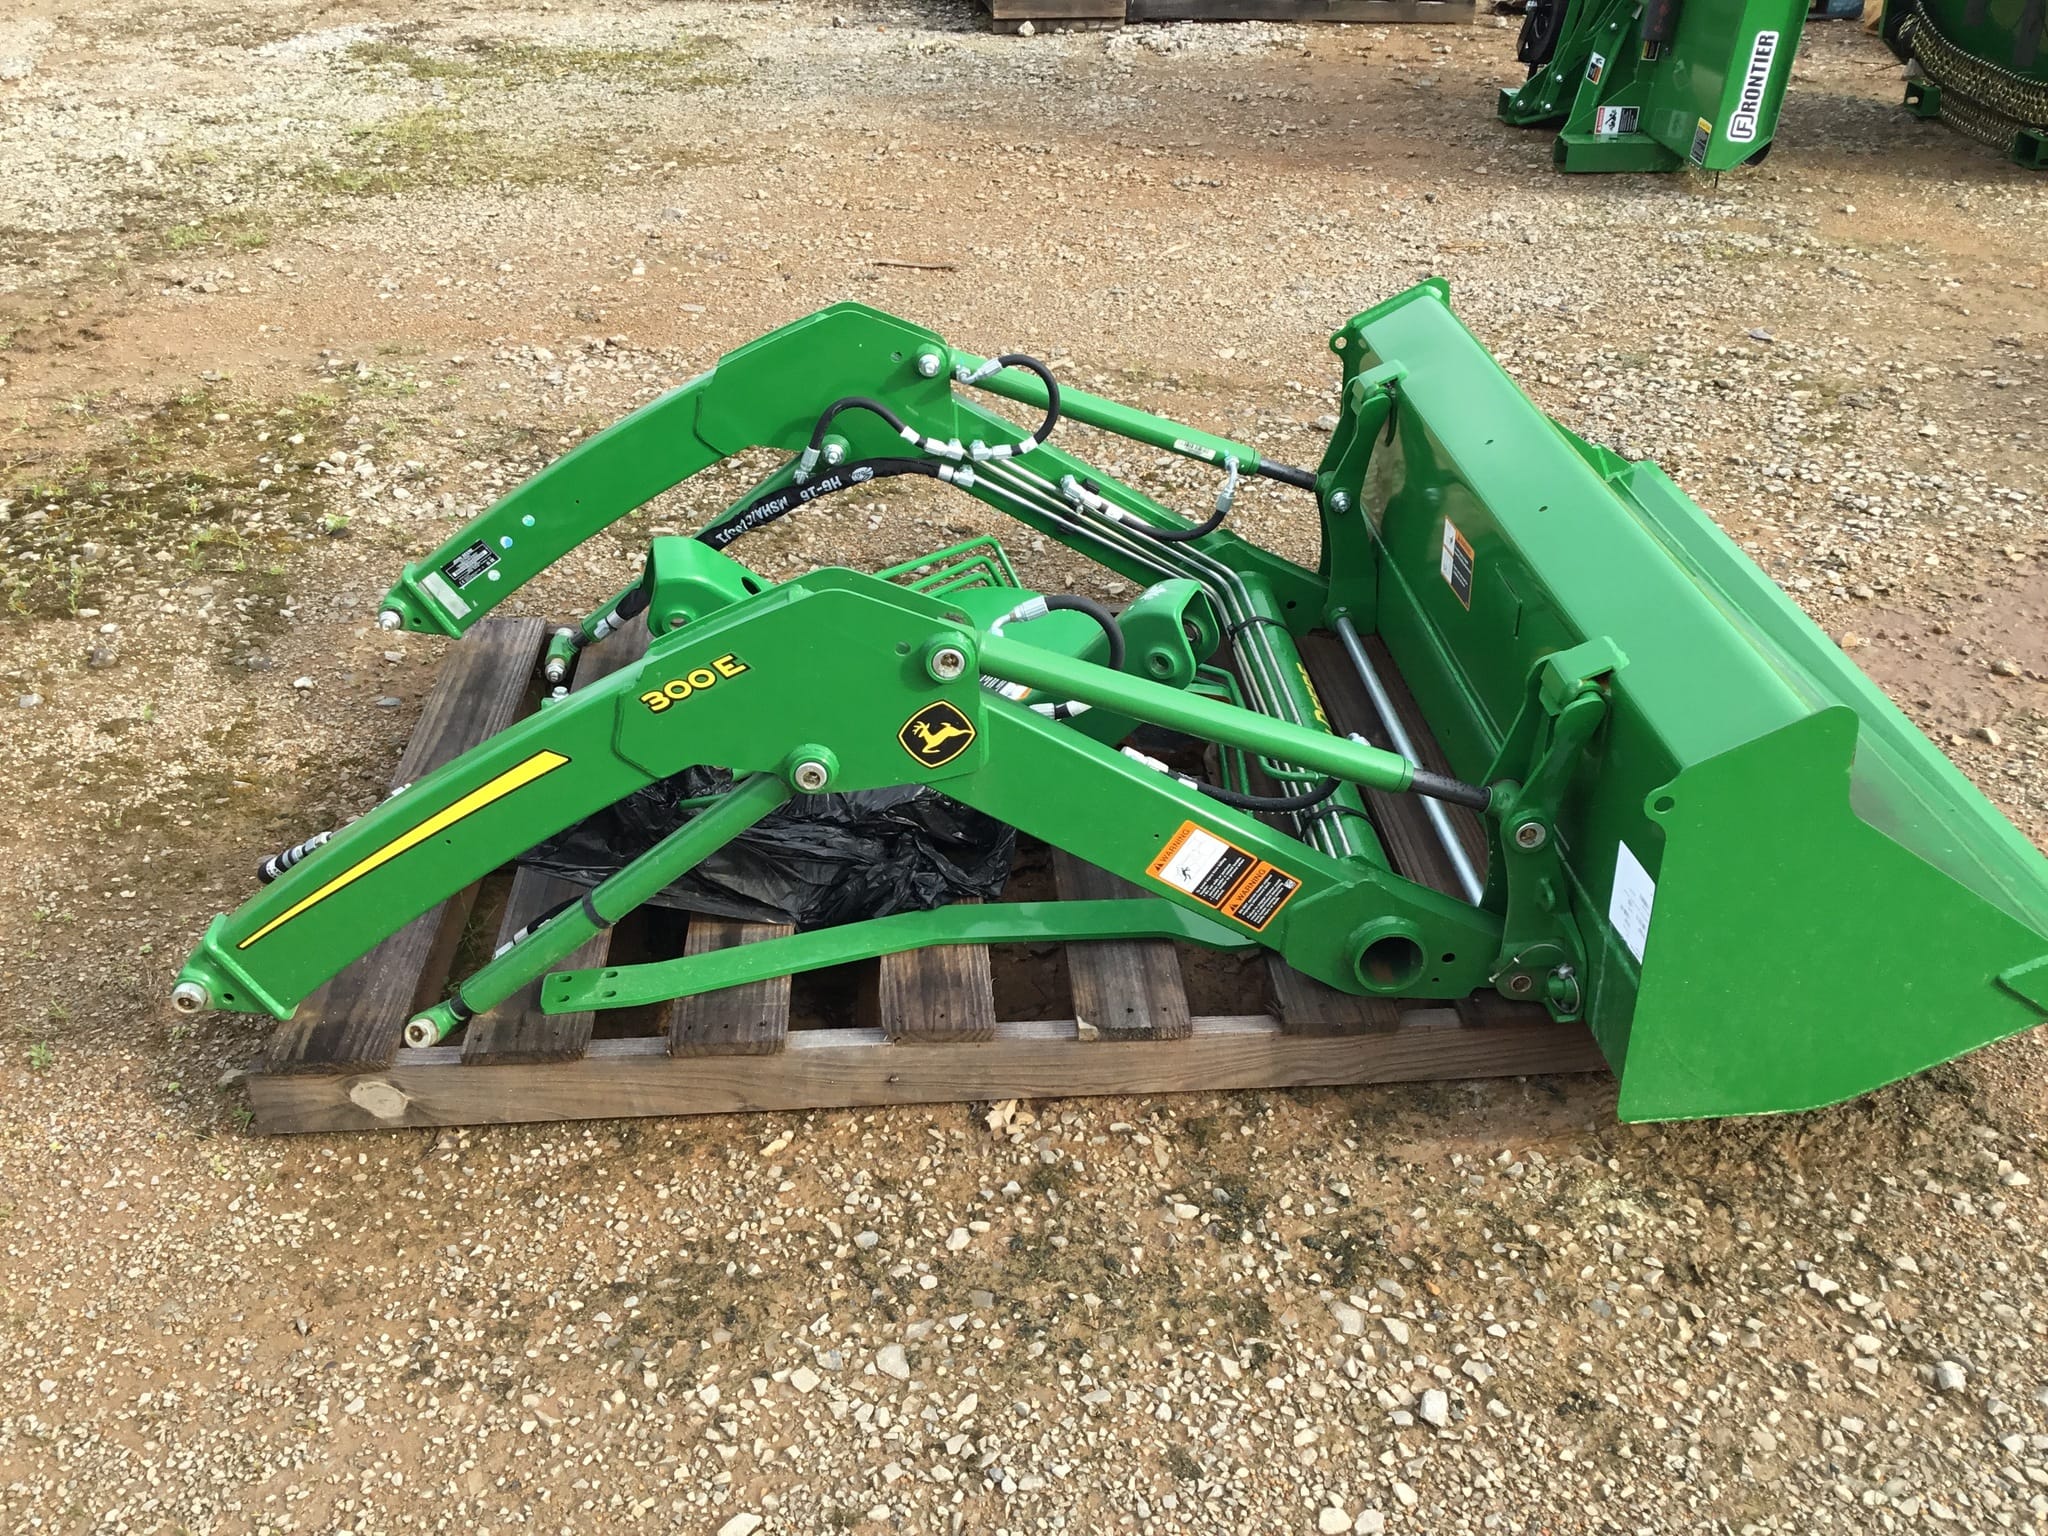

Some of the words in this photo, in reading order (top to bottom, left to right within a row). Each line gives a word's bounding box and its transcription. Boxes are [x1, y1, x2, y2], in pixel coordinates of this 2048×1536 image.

[1730, 34, 1775, 139] FRONTIER
[800, 475, 843, 501] HG-16
[638, 652, 751, 714] 300E
[1160, 829, 1190, 862] WARNING
[1238, 868, 1266, 901] WARNING
